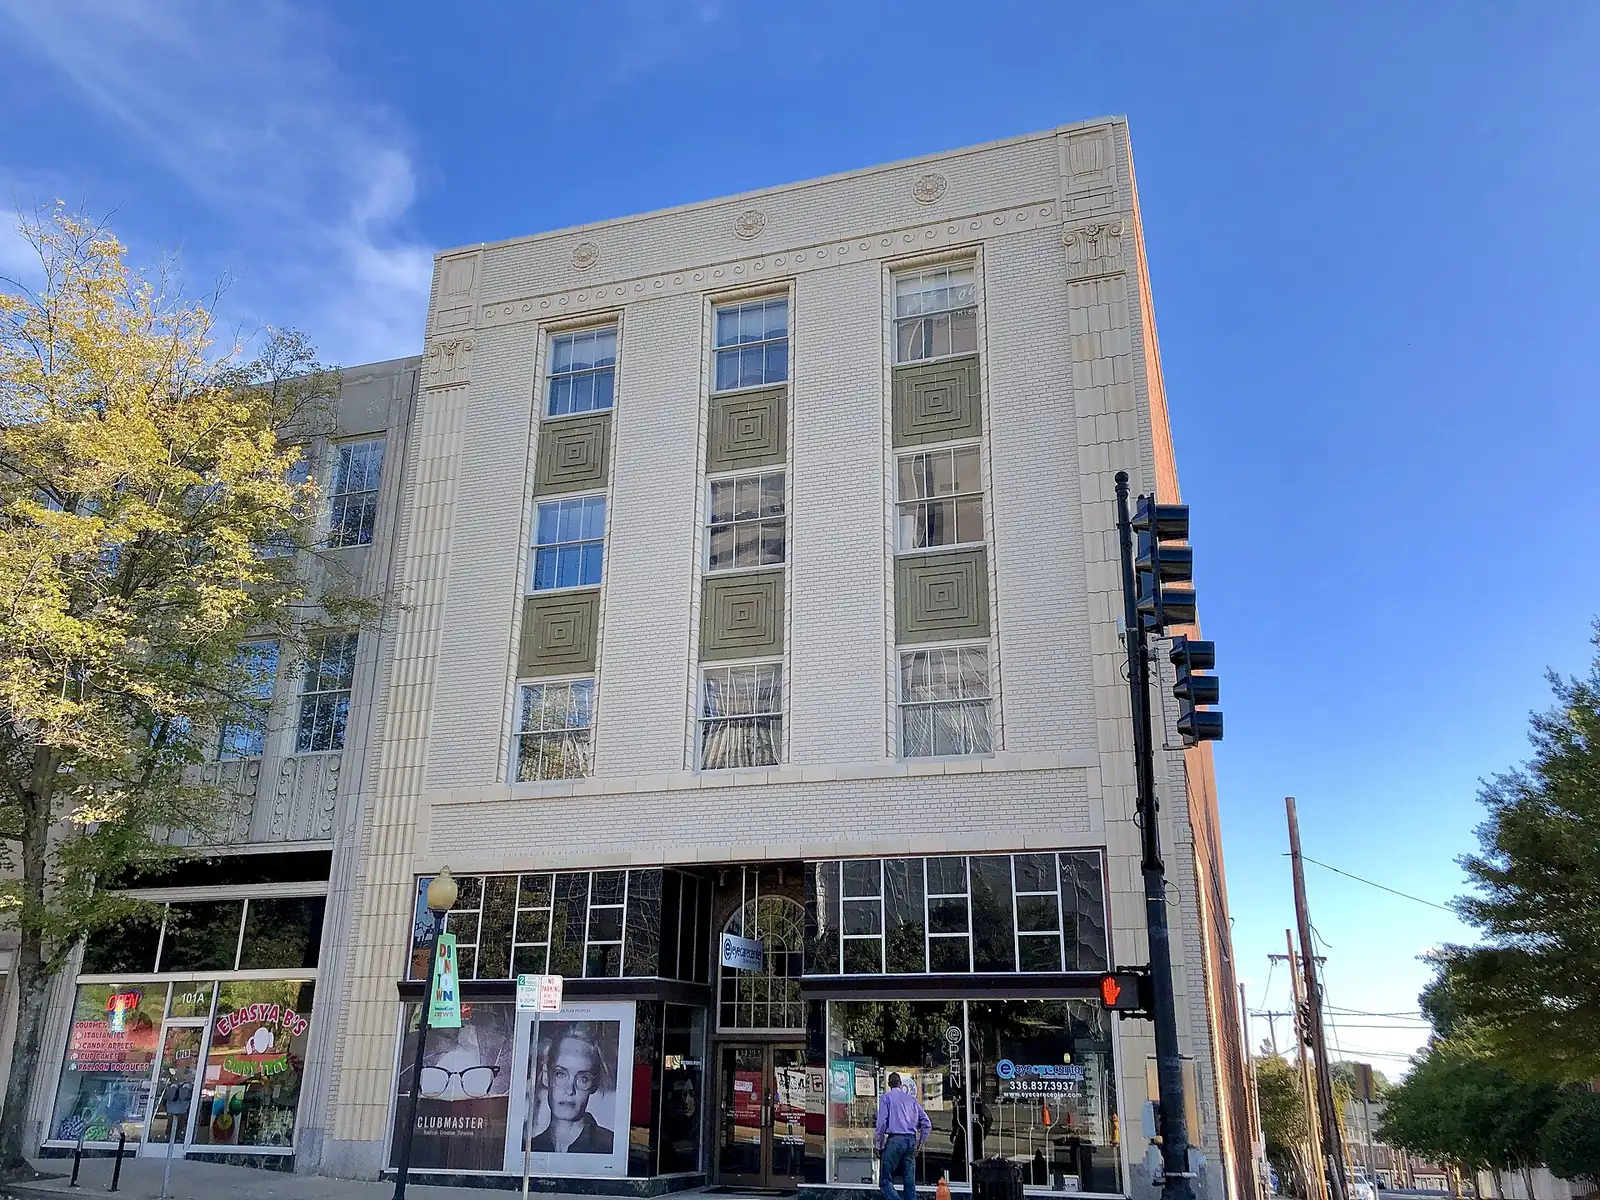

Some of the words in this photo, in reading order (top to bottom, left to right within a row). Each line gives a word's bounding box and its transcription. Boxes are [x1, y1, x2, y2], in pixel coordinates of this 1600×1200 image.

[519, 976, 525, 984] 2
[106, 993, 139, 1011] OPEN
[182, 992, 205, 1003] 101A
[217, 1003, 280, 1036] ELASYA
[282, 1008, 308, 1036] B'S
[83, 1031, 112, 1039] ITALIAN
[82, 1042, 106, 1050] CANDY
[107, 1042, 133, 1050] APPLES
[78, 1062, 110, 1071] BALLOON
[110, 1062, 149, 1071] BOUQUETS
[1015, 1064, 1083, 1076] eyecarecenter
[1009, 1081, 1074, 1090] 336.837.3937
[417, 1116, 484, 1129] CLUBMASTER
